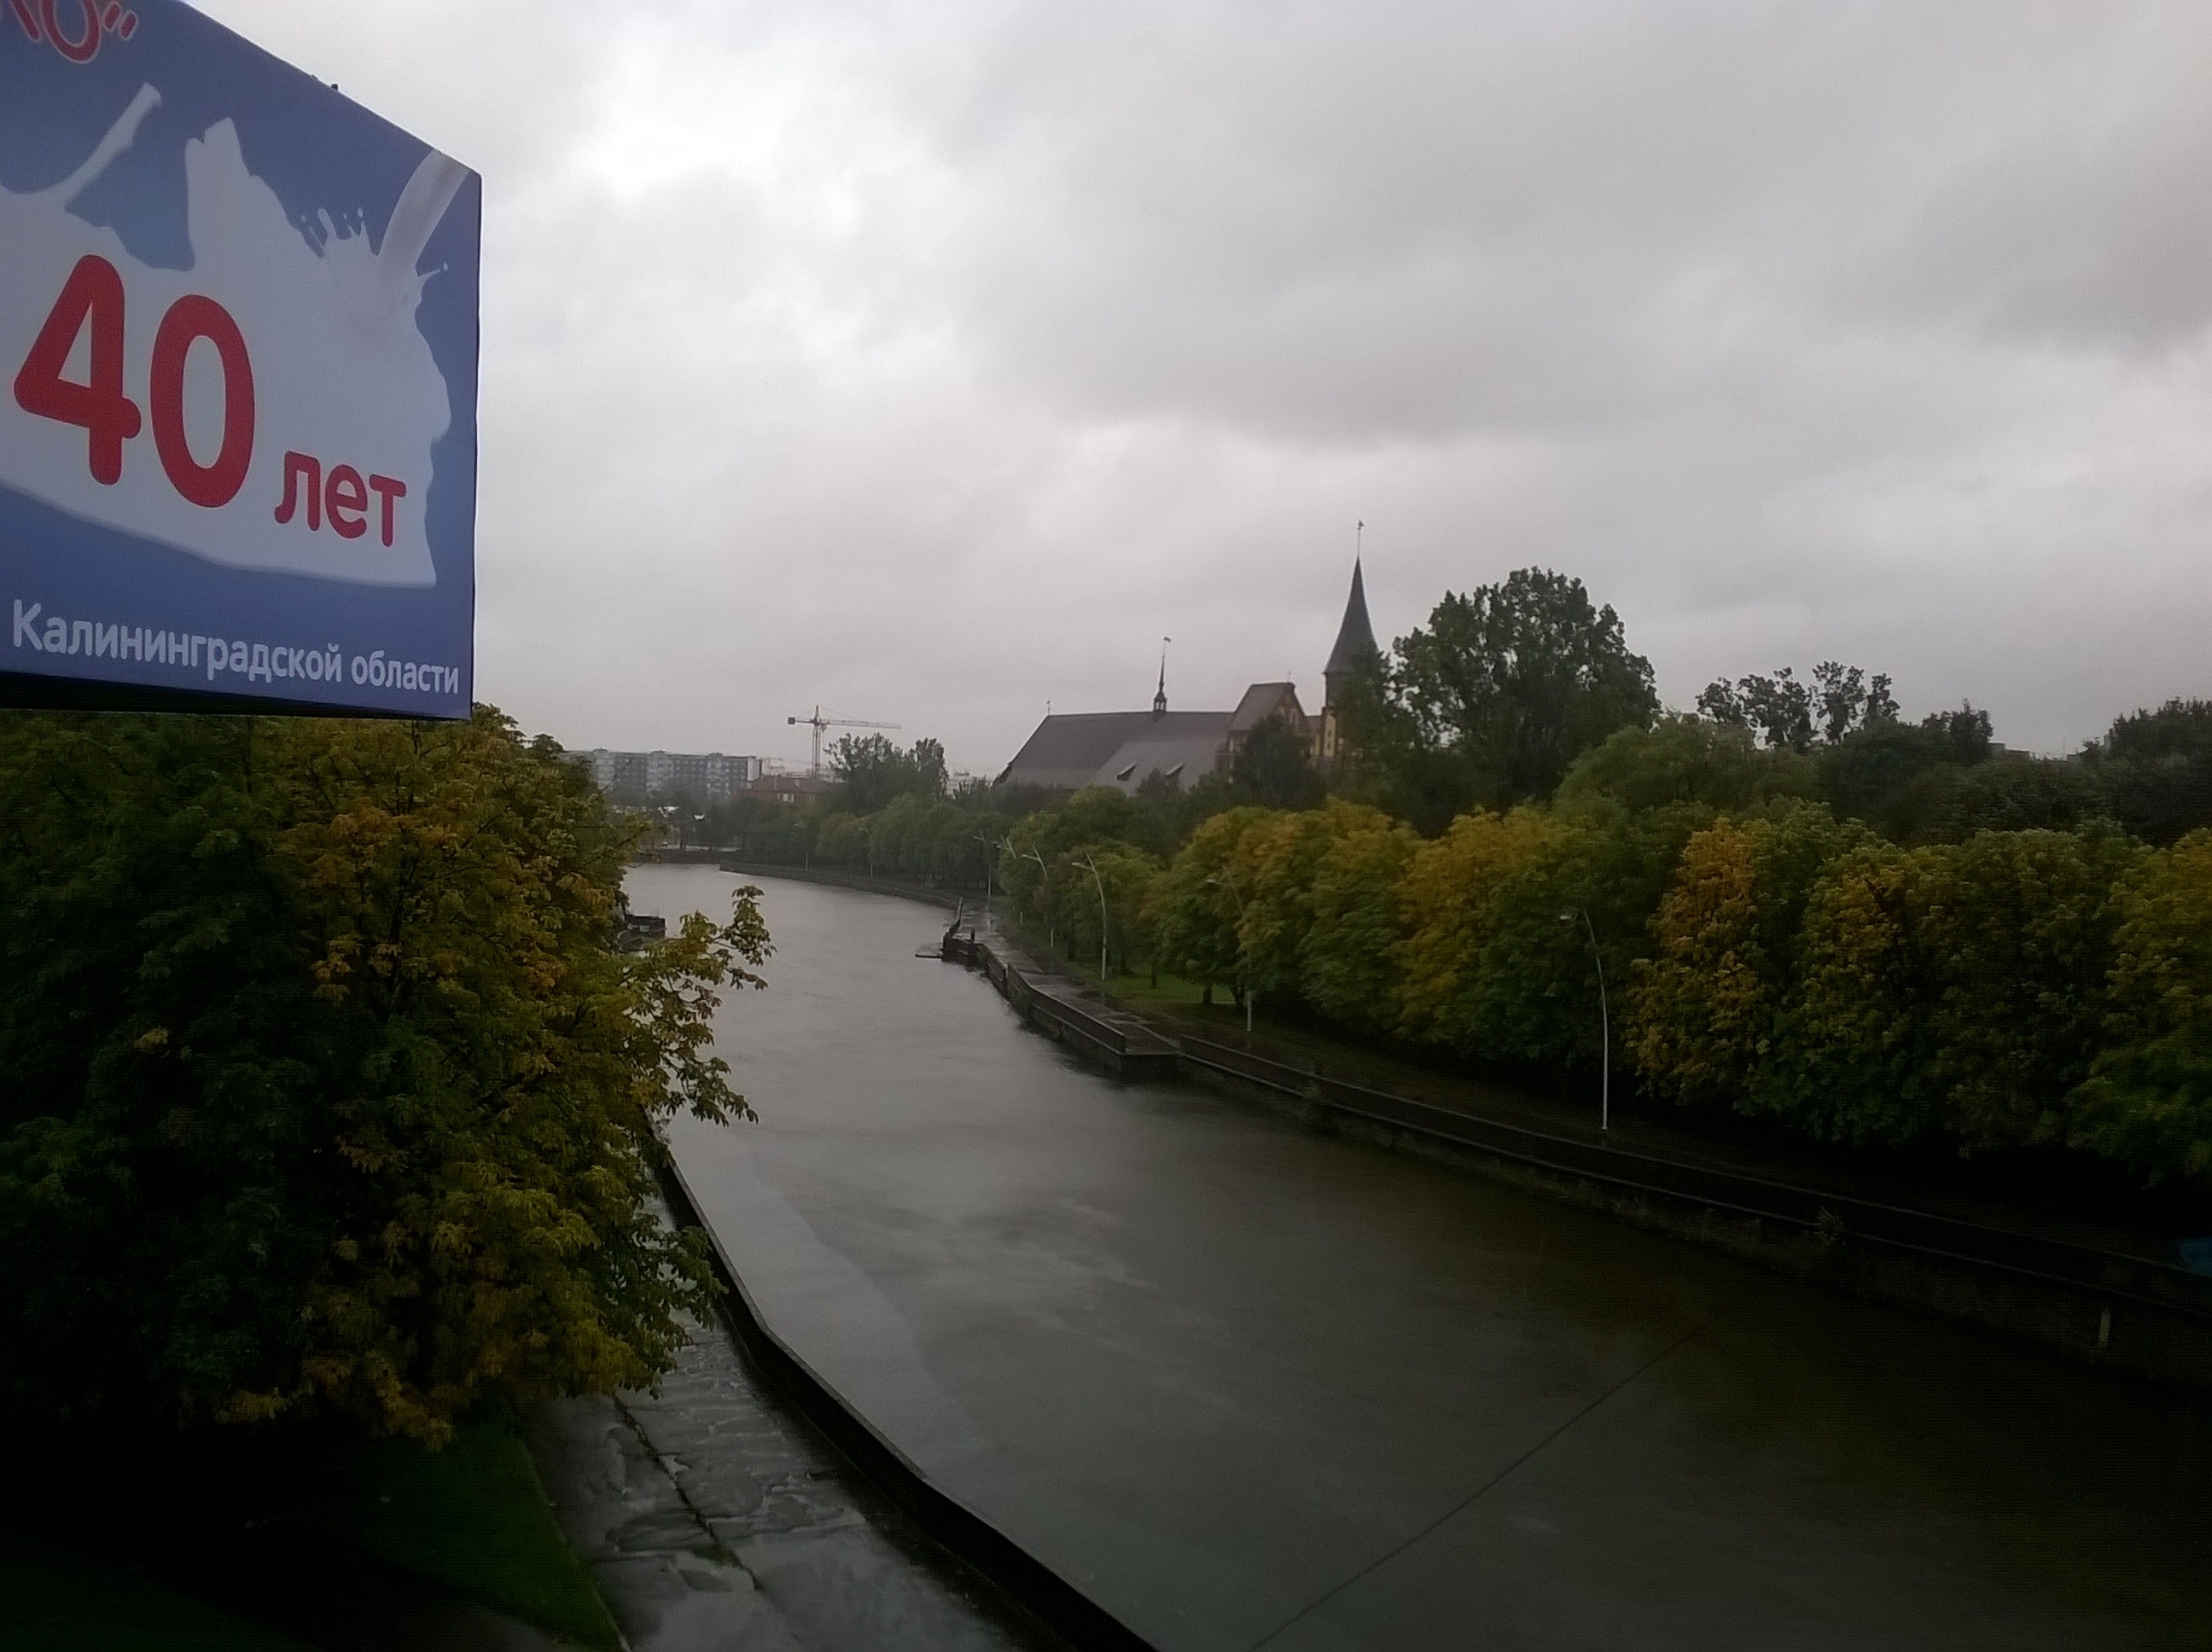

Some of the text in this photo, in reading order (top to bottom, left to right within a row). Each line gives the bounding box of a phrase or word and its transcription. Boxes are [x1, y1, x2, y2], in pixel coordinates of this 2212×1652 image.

[14, 253, 406, 547] 40 лет
[13, 599, 458, 695] Калининградской области
